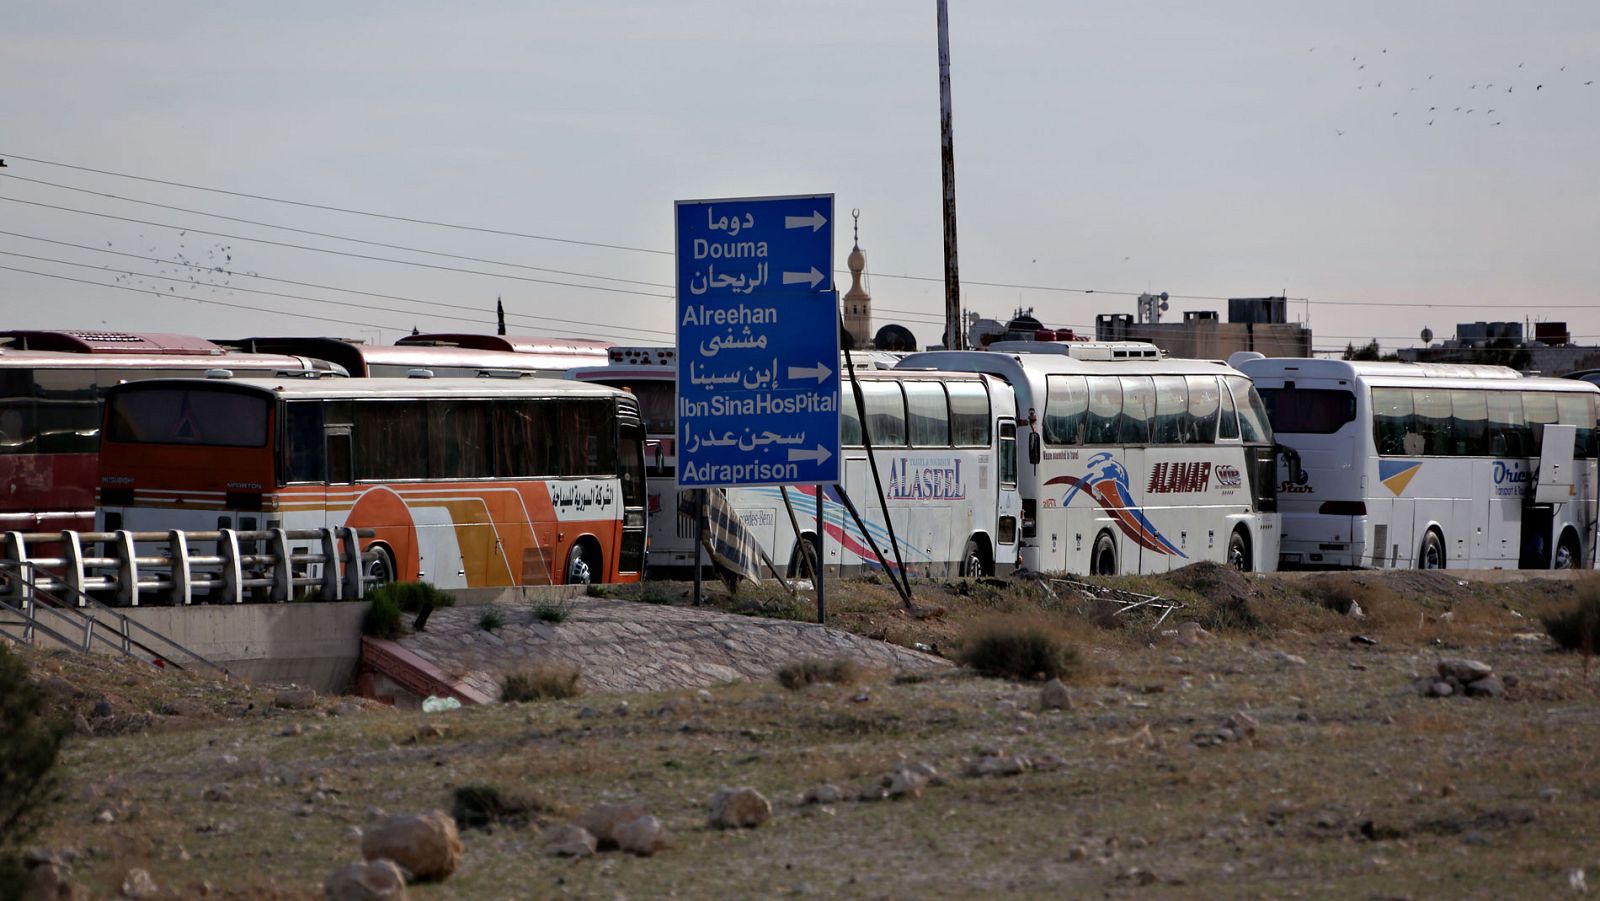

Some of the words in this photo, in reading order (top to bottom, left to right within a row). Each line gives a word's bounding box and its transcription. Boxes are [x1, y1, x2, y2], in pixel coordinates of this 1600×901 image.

[708, 206, 754, 236] دوما
[693, 238, 768, 259] Douma
[690, 261, 768, 294] الريحان
[682, 303, 777, 326] Alreehan
[690, 359, 741, 390] سينا
[743, 356, 779, 390] إبن
[680, 396, 709, 417] Ibn
[711, 395, 754, 416] Sina
[756, 391, 837, 415] Hospital
[685, 421, 738, 453] عدرا
[738, 427, 805, 453] سجن
[682, 459, 798, 484] Adraprison
[887, 457, 966, 500] ALASEEL
[1146, 462, 1211, 493] ALAMAR
